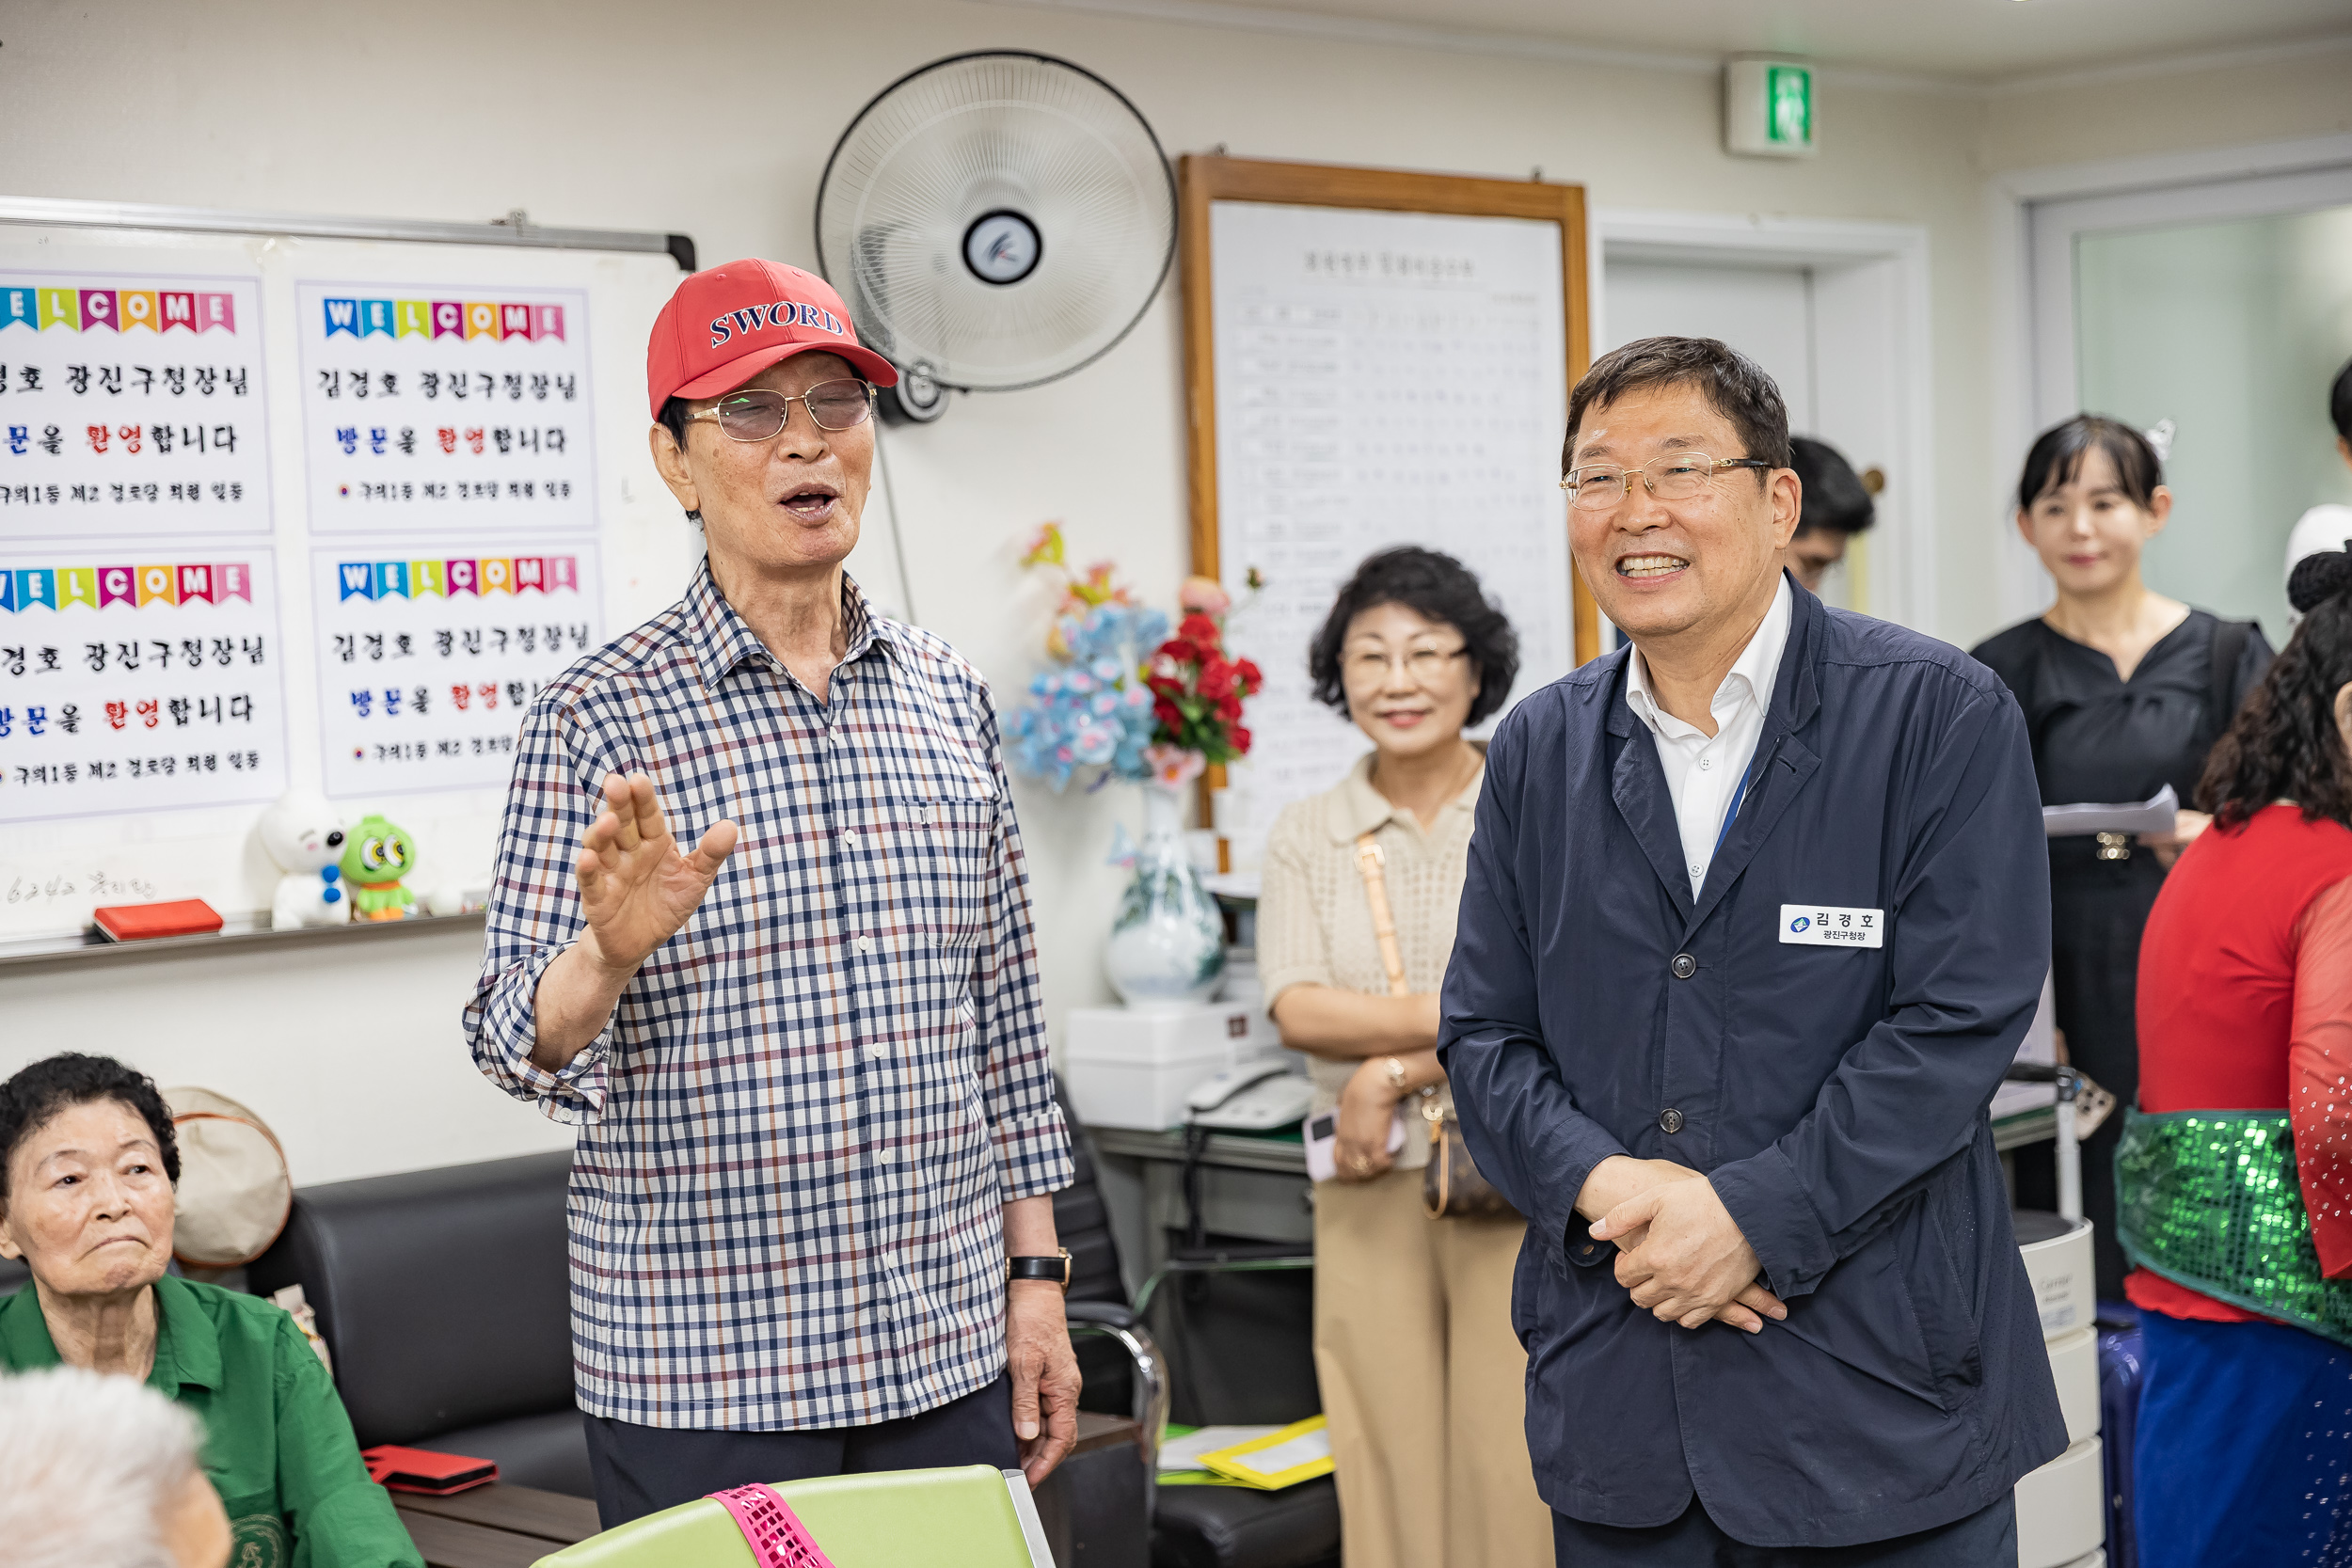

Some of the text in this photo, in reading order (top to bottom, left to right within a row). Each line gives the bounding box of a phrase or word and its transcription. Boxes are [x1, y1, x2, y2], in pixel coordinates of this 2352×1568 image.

[9, 291, 224, 323] ELCOME
[327, 301, 557, 332] WELCOME
[710, 300, 845, 349] SWORD
[318, 370, 400, 400] 김경호
[4, 424, 237, 455] 문을 환영합니다
[336, 426, 566, 455] 방문을 환영합니다
[342, 559, 571, 591] WELCOME
[1, 646, 62, 676] 경호
[333, 632, 414, 662] 김경호
[103, 693, 254, 732] 환영합니다
[350, 680, 539, 718] 방문을 환영합
[1817, 912, 1873, 927] 김경호
[1823, 930, 1866, 941] 광진구청장
